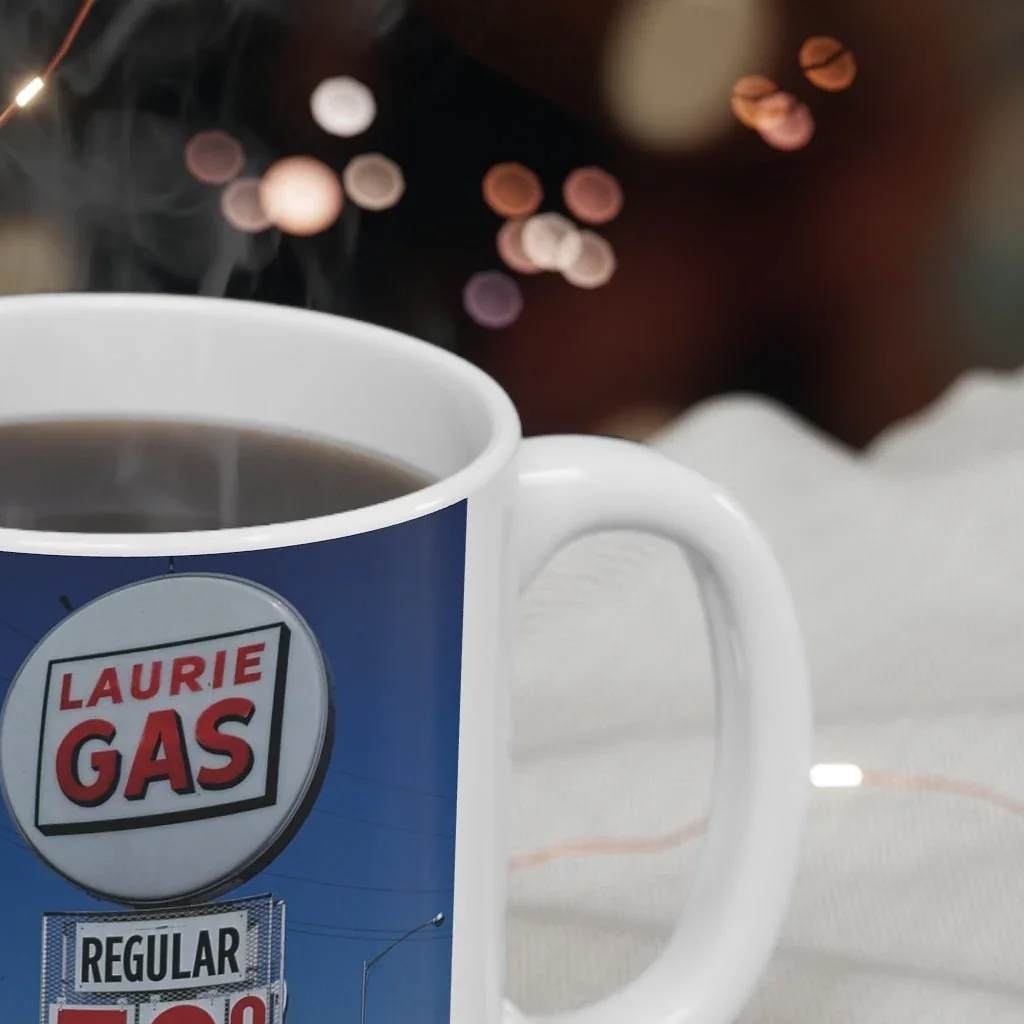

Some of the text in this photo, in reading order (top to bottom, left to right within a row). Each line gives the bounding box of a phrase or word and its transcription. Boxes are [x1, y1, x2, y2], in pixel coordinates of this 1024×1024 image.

[59, 642, 266, 711] LAURIE
[55, 696, 256, 807] GAS
[80, 926, 241, 983] REGULAR
